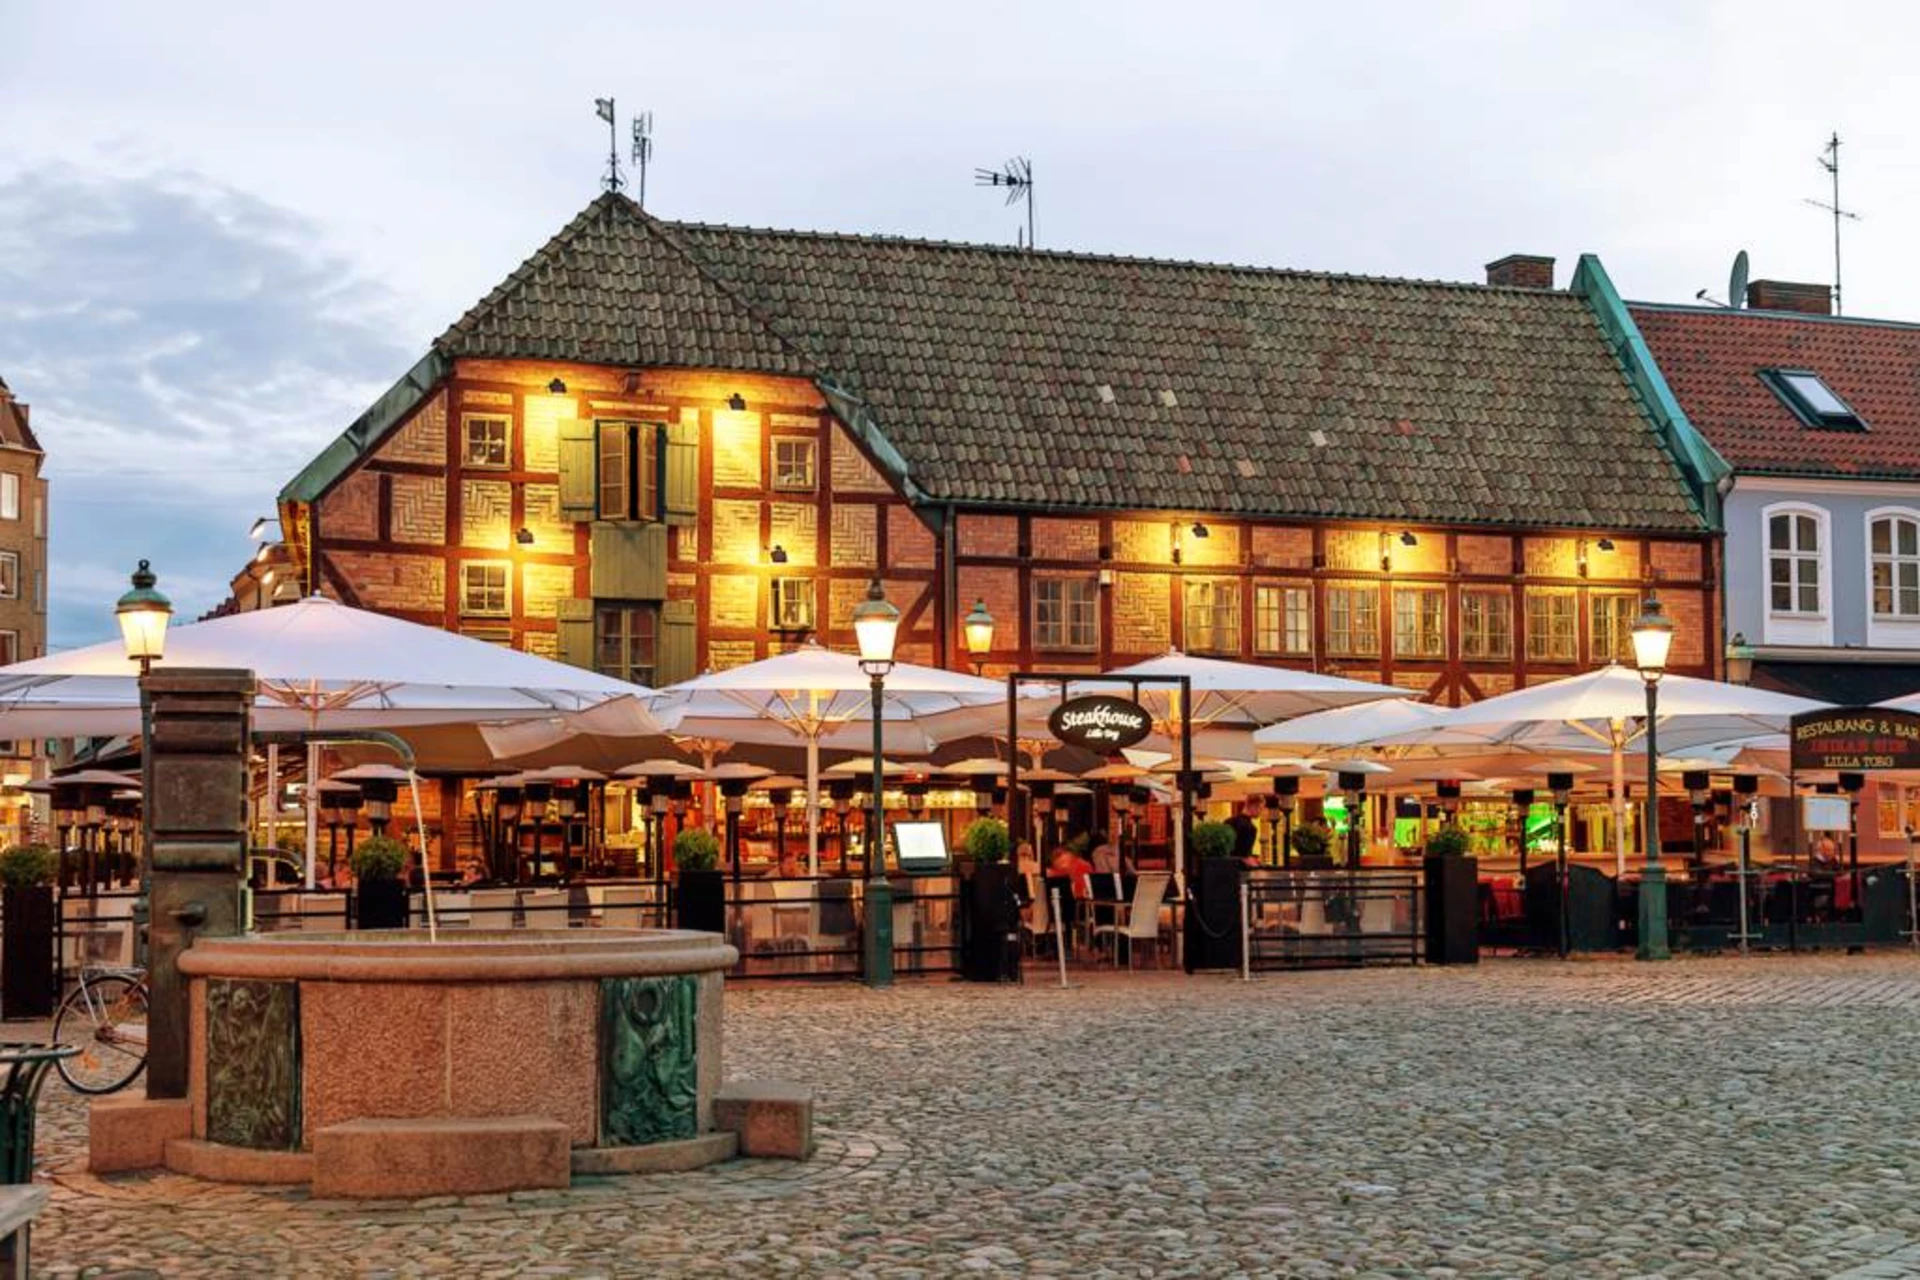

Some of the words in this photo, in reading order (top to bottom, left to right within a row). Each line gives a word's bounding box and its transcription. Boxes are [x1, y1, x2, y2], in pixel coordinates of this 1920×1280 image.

[1061, 705, 1142, 730] Steakhouse
[1796, 719, 1874, 740] RESTAURANG
[1880, 721, 1890, 734] &
[1894, 722, 1920, 741] BAR
[1824, 756, 1861, 767] LILLA
[1862, 756, 1894, 767] TORG
